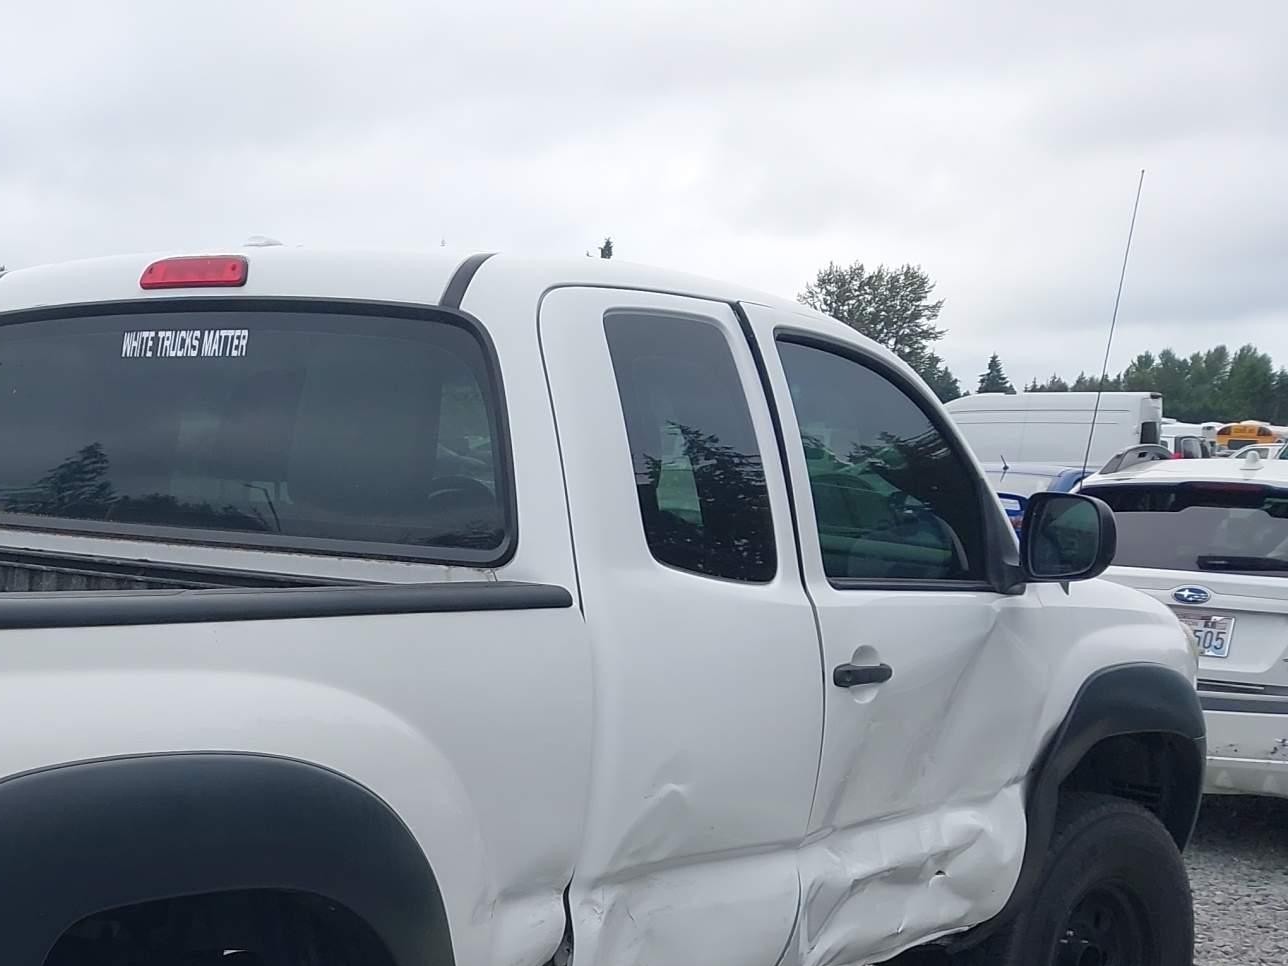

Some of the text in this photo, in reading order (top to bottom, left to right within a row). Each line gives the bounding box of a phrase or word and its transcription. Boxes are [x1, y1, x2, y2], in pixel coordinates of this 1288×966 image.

[121, 329, 249, 357] WHITE TRUCKS MATTER
